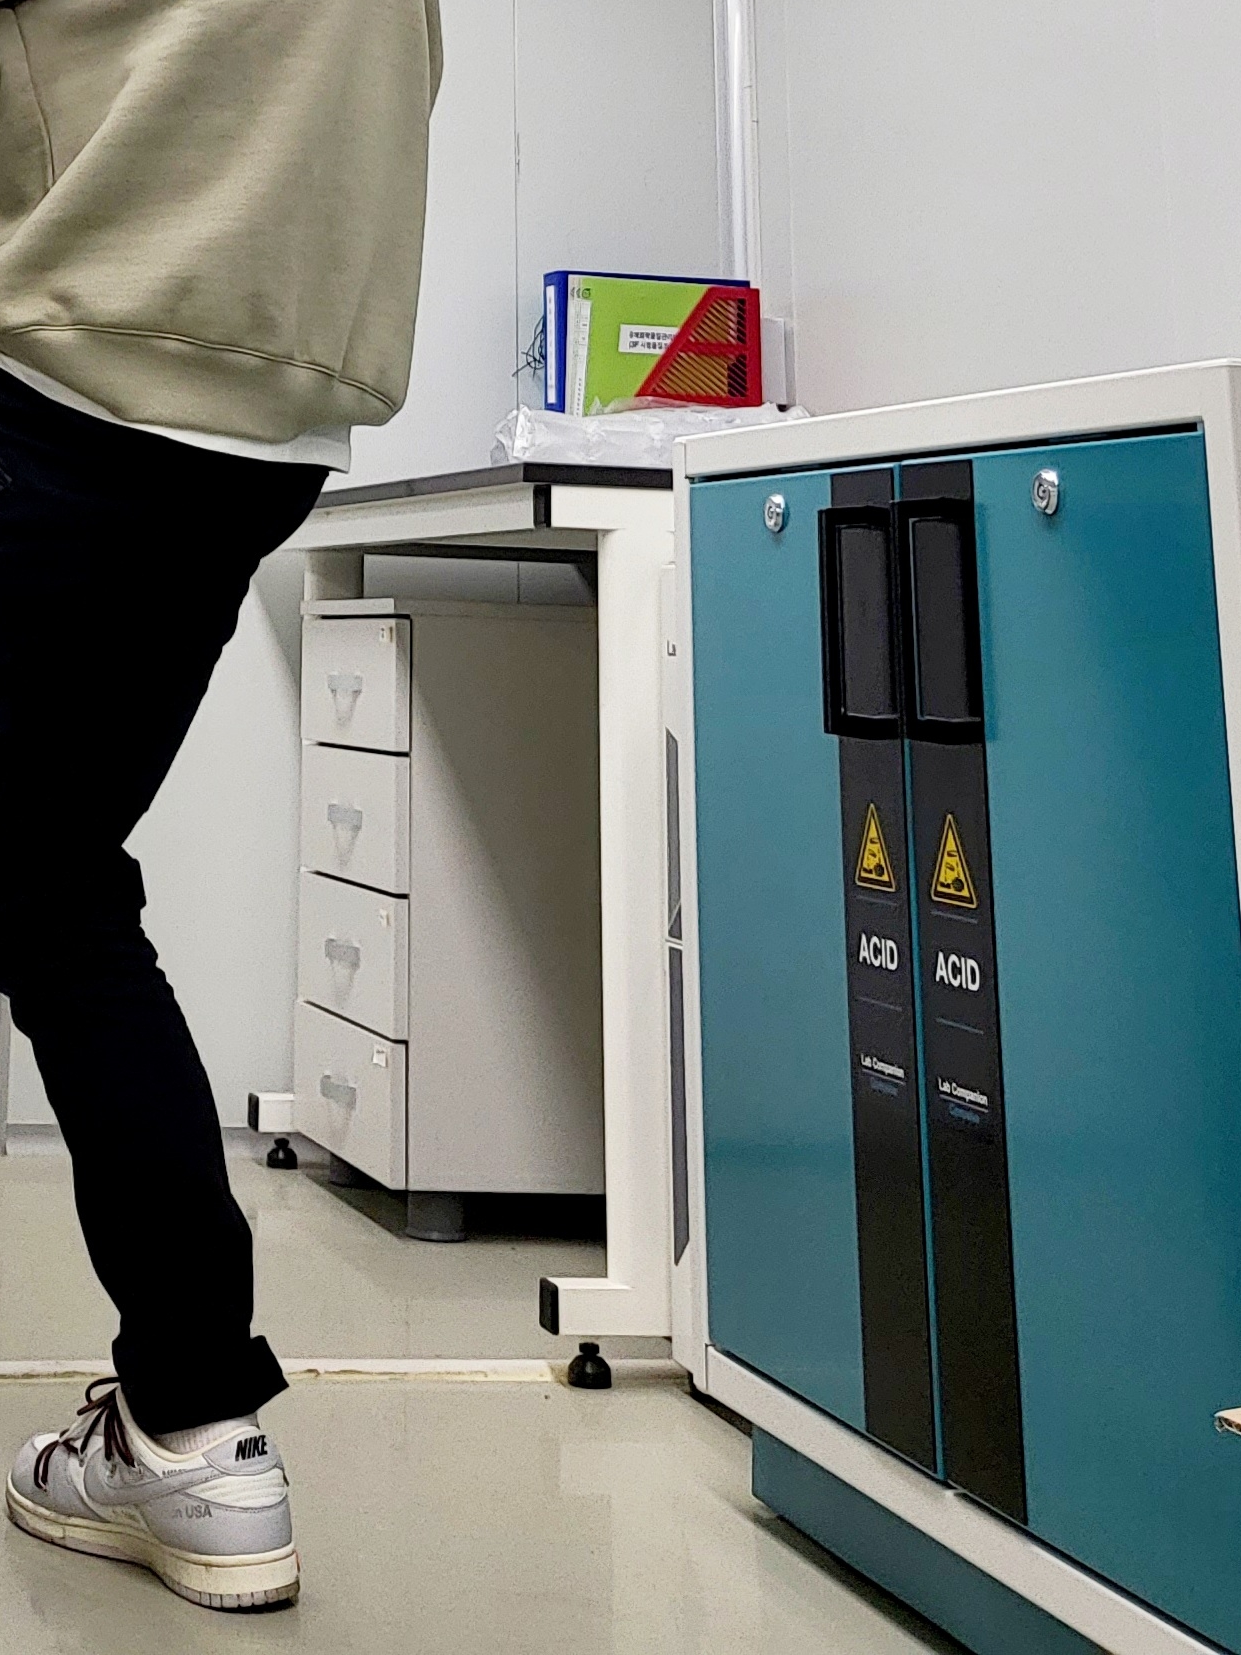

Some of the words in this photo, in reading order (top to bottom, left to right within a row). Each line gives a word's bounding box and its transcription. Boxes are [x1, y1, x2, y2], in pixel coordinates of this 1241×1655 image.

[859, 932, 898, 971] ACID
[936, 950, 980, 992] ACID
[860, 1052, 872, 1068] Lab
[937, 1076, 951, 1094] Lab
[951, 1081, 988, 1107] Companion
[235, 1434, 268, 1462] NIKE
[185, 1504, 212, 1519] USA
